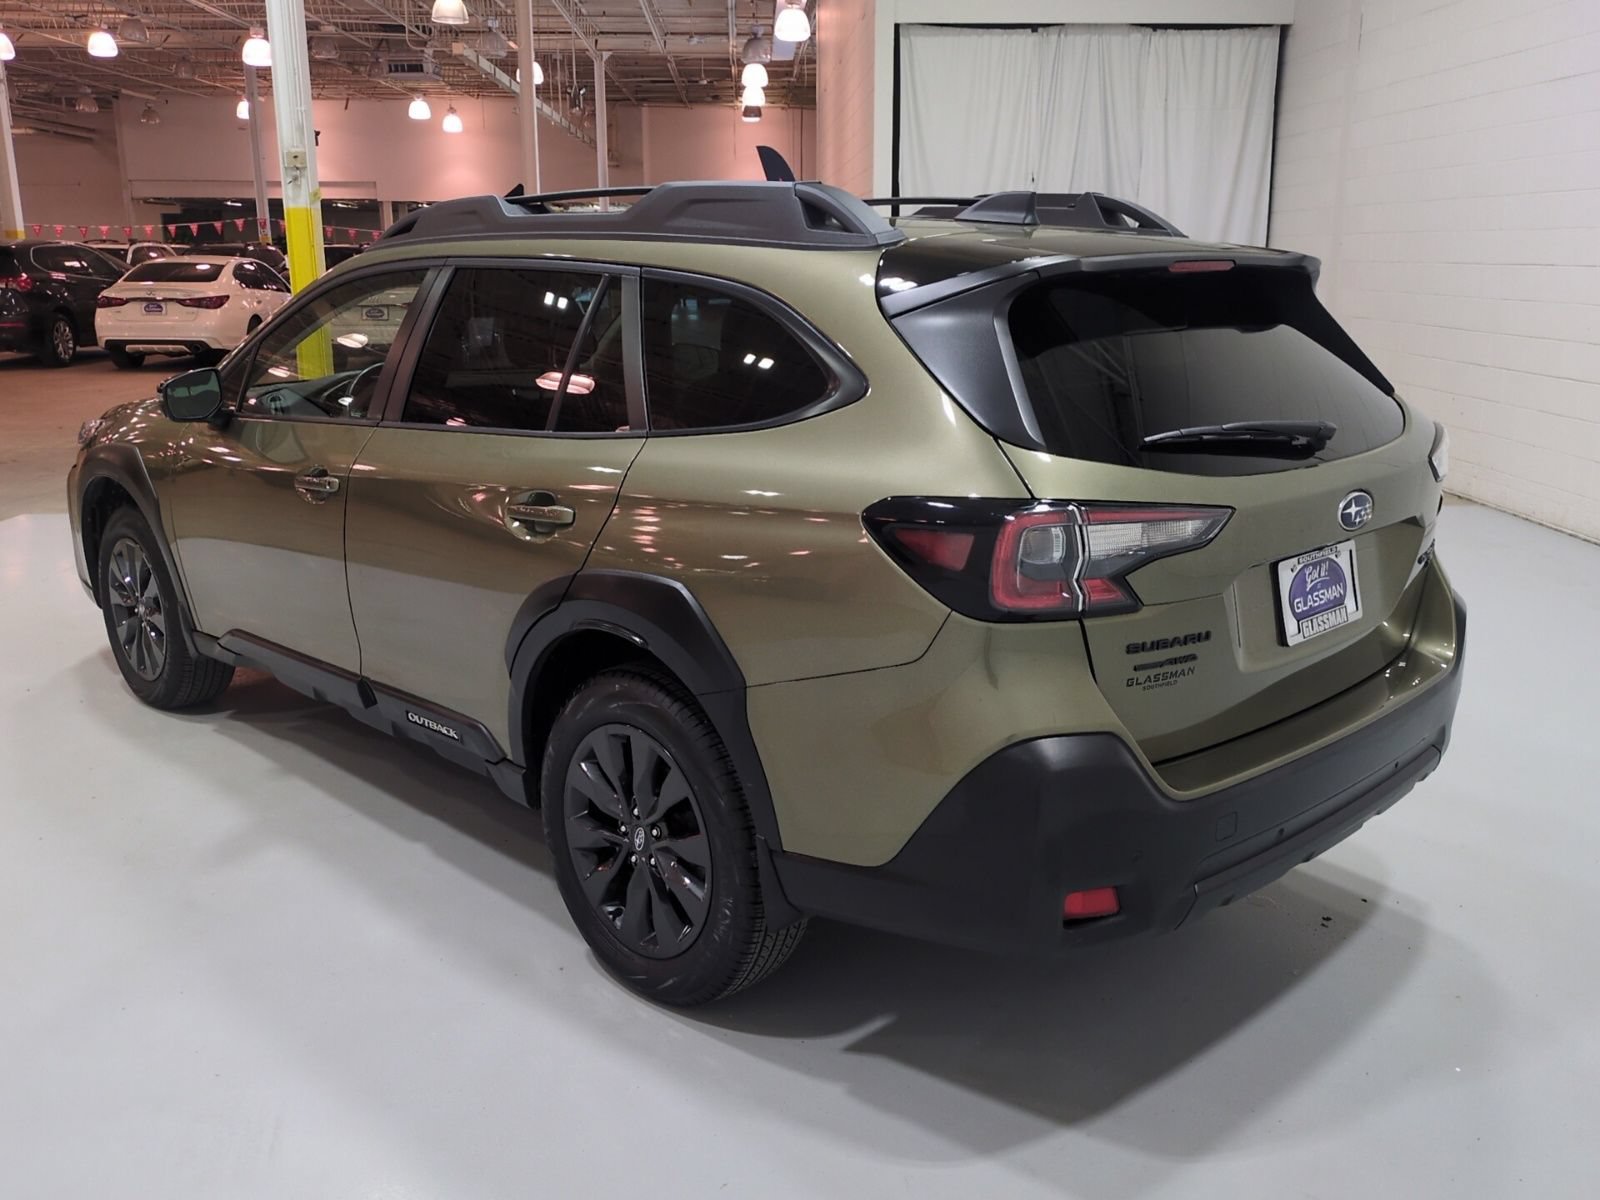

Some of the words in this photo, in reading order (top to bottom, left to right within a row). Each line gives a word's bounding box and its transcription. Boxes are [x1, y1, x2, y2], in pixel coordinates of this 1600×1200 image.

[1305, 564, 1320, 583] Got
[1293, 583, 1345, 613] GLASSMAN
[1302, 606, 1347, 638] GLASSMAN
[1126, 630, 1212, 654] SUBARU
[1126, 666, 1196, 687] GLASSMAN
[1142, 680, 1178, 691] SOUTHFIELD
[408, 712, 459, 740] OUTBACK
